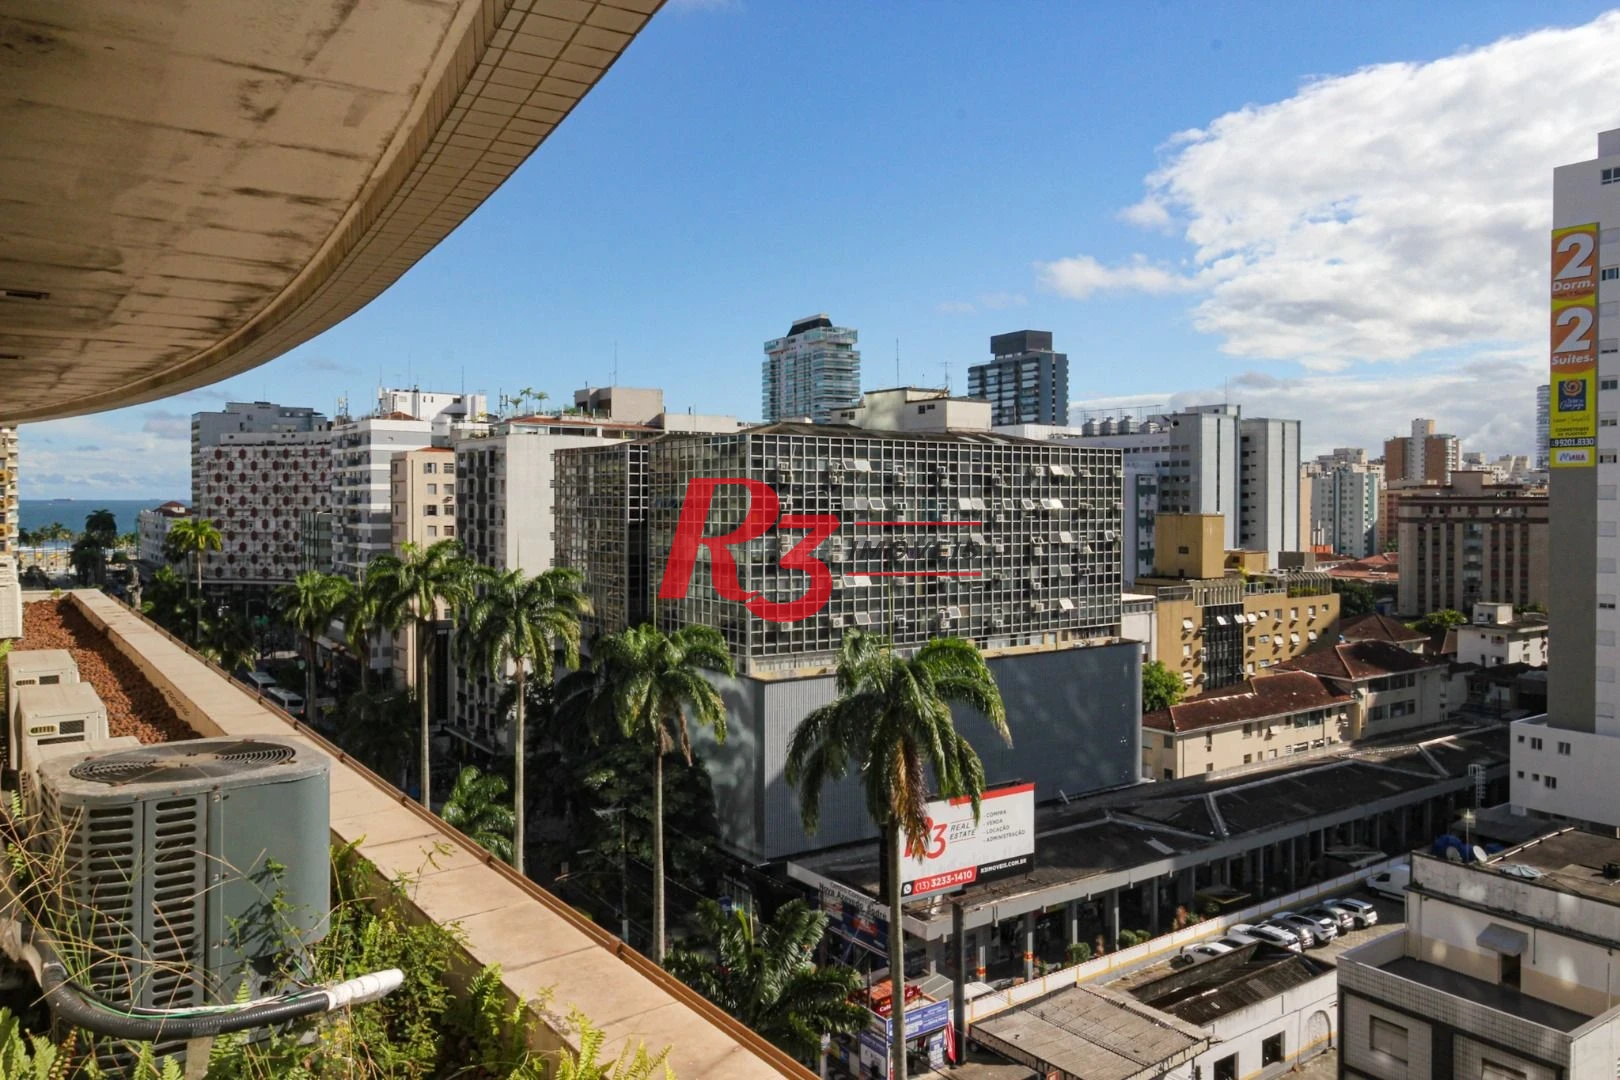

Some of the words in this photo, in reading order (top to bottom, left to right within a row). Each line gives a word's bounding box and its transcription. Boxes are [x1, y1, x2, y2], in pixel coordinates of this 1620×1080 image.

[1553, 232, 1595, 281] 2
[1552, 280, 1595, 291] Dorm.
[1552, 306, 1593, 354] 2
[986, 809, 1007, 818] COMPRA
[950, 822, 971, 832] REAL
[986, 825, 1010, 835] LOCAÇÃO
[949, 829, 976, 841] ESTATE
[986, 829, 1026, 843] ADMINISTRAÇÃO
[915, 880, 930, 892] (13)
[931, 870, 973, 888] 3233-1410
